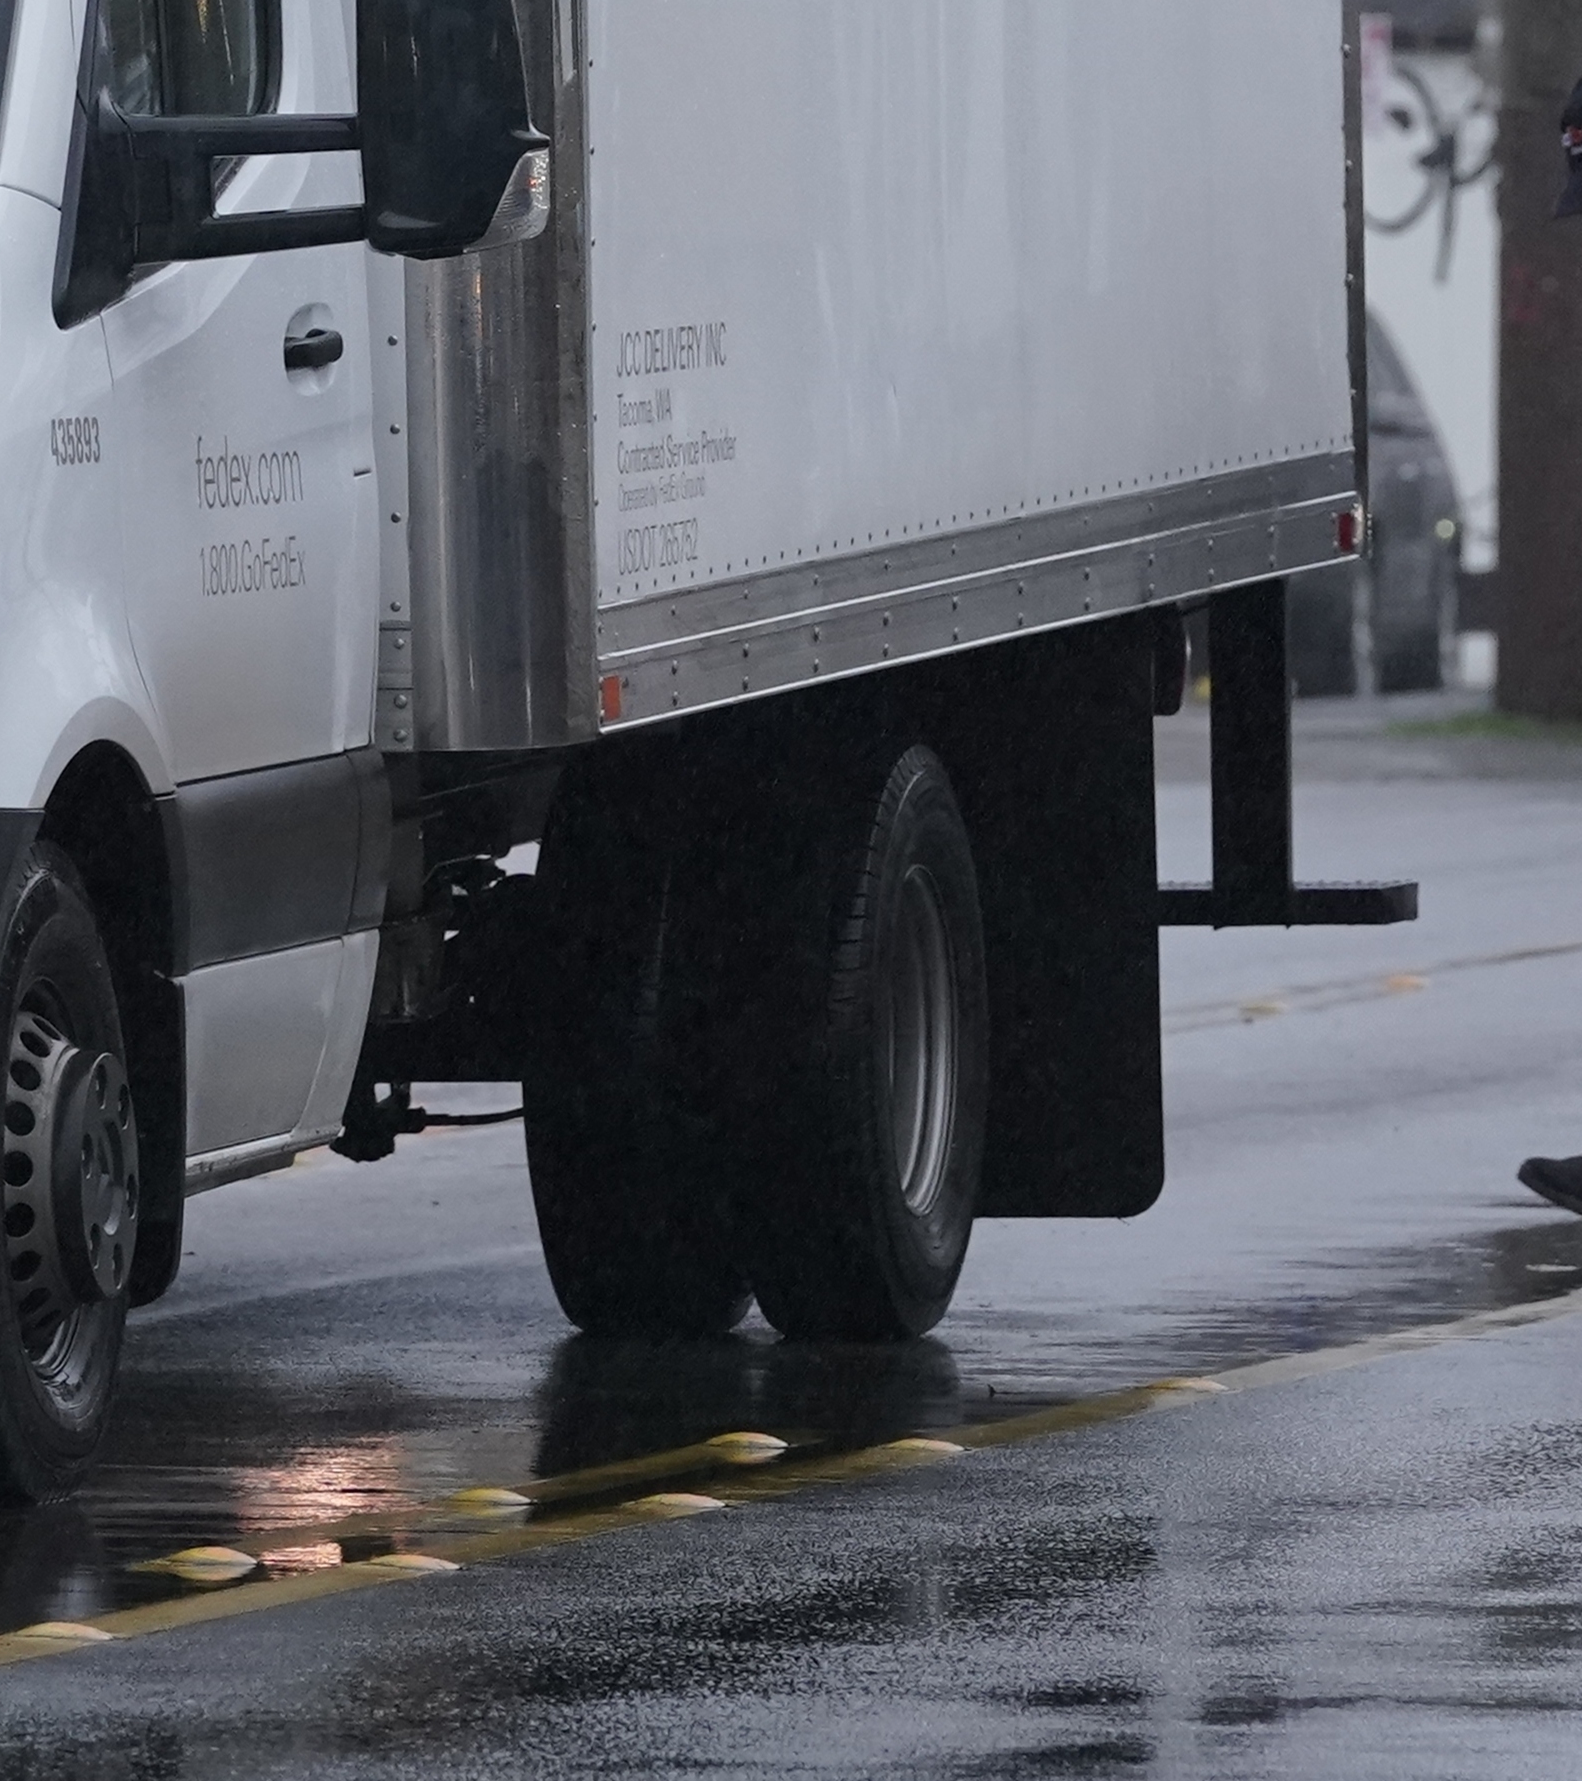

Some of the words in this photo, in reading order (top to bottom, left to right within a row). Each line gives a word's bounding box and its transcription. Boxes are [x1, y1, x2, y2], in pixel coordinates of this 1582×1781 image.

[617, 331, 642, 378] JCC
[644, 324, 704, 374] DELIVERY
[705, 321, 727, 369] INC
[655, 388, 672, 422] WA
[51, 417, 101, 466] 435893
[618, 436, 665, 474] Contracted
[666, 433, 699, 468] Service
[700, 427, 736, 463] Provider
[195, 435, 304, 509] fedex.com
[199, 536, 306, 597] 1.800.GoFedEx
[617, 526, 657, 576] USDOT
[659, 517, 699, 567] 265752
